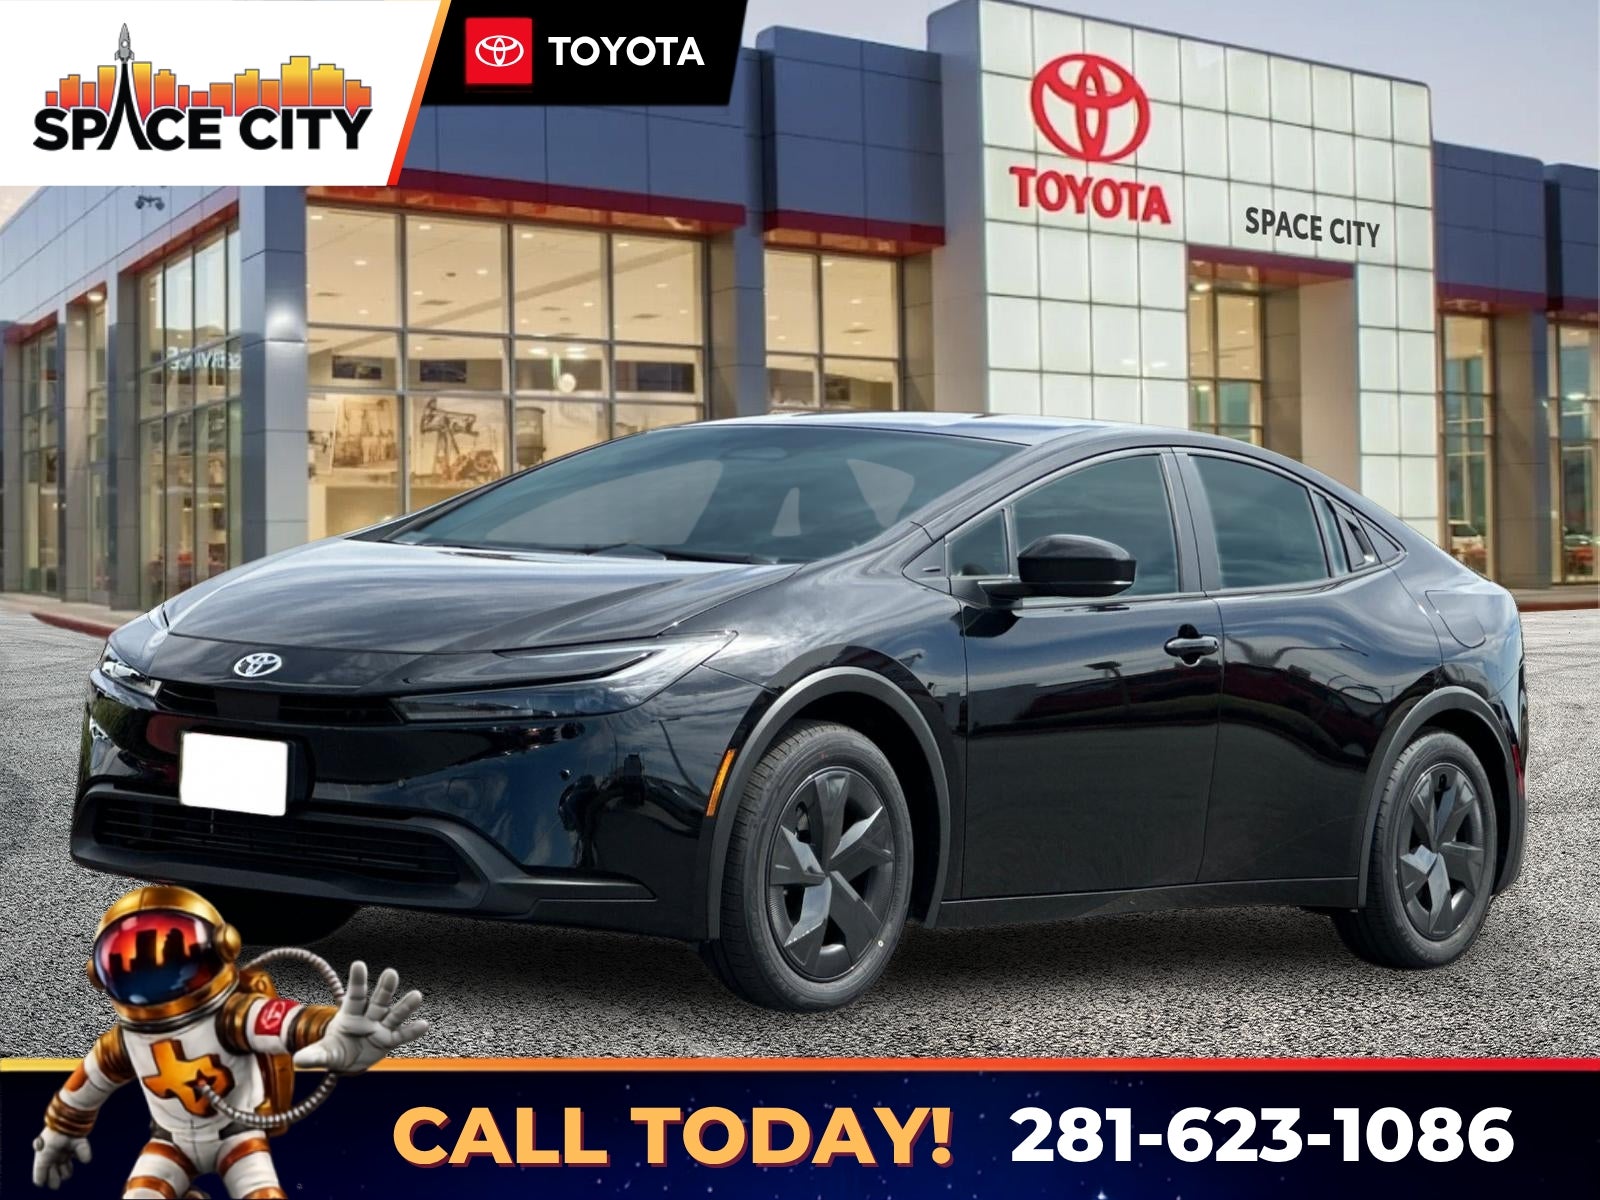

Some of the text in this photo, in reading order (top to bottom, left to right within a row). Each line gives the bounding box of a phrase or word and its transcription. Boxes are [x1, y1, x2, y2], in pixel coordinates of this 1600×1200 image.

[1009, 166, 1171, 224] TOYOTA
[1245, 207, 1381, 248] SPACE CITY
